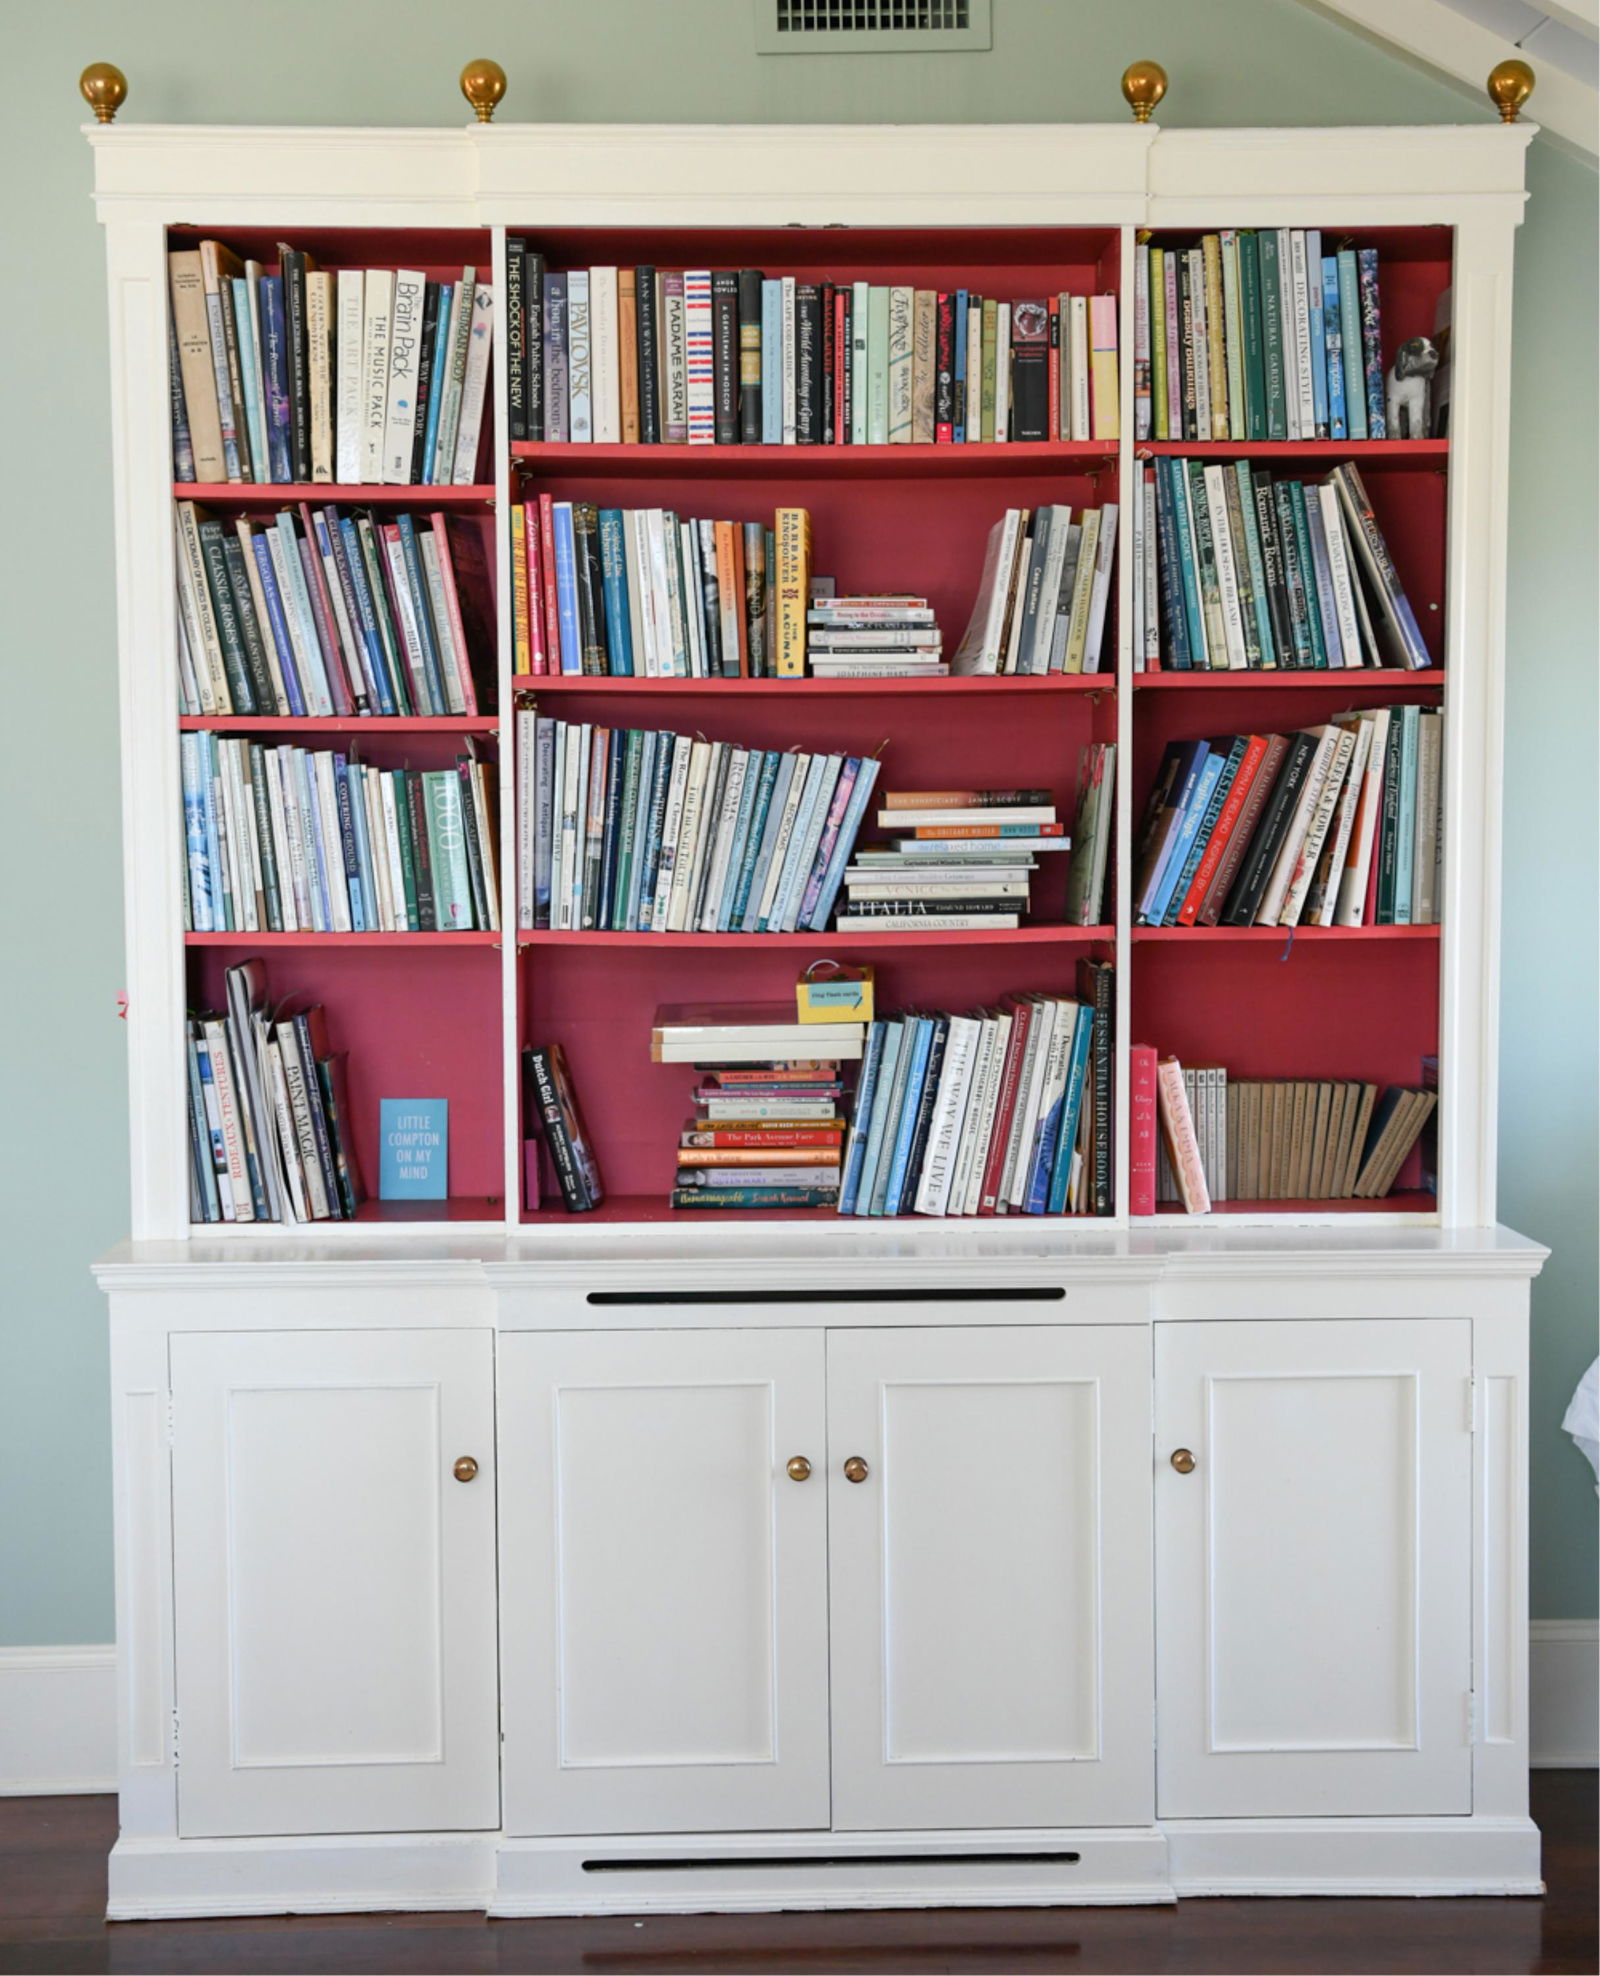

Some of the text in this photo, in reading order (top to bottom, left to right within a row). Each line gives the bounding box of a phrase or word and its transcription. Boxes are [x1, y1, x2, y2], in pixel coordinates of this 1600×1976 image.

[461, 281, 473, 305] THE
[784, 300, 792, 322] CAPE
[1152, 253, 1164, 353] THE ENGLISH ROOM
[293, 321, 301, 355] VICTORIAN
[391, 282, 419, 379] Brain Pack
[455, 307, 470, 349] HUMAN
[509, 256, 522, 408] THE SHOCK OF THE NEW
[670, 299, 682, 366] MADAME
[722, 314, 730, 361] GENTLEMAN
[785, 323, 793, 342] COD
[1266, 294, 1277, 348] NATURAL
[1295, 281, 1310, 364] DECORATING
[294, 356, 302, 377] HOUSE
[345, 295, 360, 417] THE ART PACK
[370, 316, 387, 429] THE MUSIC PACK
[419, 360, 430, 383] WAY
[452, 351, 464, 385] BODY
[530, 304, 541, 409] English Public Schools
[551, 287, 563, 426] a lion in the bedroom
[569, 302, 589, 400] PAVLOVSK
[723, 363, 730, 372] IN
[785, 343, 793, 379] GARDEN
[916, 311, 930, 386] The Collector
[1330, 334, 1341, 397] the hamptons
[295, 379, 303, 398] BOOK
[419, 384, 427, 401] WE
[672, 371, 683, 421] SARAH
[723, 375, 731, 412] MOSCOW
[1269, 353, 1280, 400] GARDEN
[1300, 367, 1312, 408] STYLE
[414, 403, 426, 437] WORK
[1174, 465, 1192, 561] LIVING WITH BOOKS
[1193, 476, 1212, 550] LANNING ROPER
[1259, 486, 1278, 588] Romantic Rooms
[1279, 495, 1292, 543] GARDEN
[256, 543, 275, 599] PERGOLAS
[327, 519, 357, 619] GLORIOUS GARDENS
[782, 513, 790, 583] KINGSOLVER
[791, 513, 799, 584] BARBARA
[1135, 531, 1143, 561] PARIS
[1166, 515, 1181, 596] inspirational interiors
[183, 510, 214, 642] THE DICTIONARY OF ROSES IN COLOUR
[208, 545, 238, 646] CLASSIC ROSES
[529, 568, 540, 633] Toni Morrison
[1029, 567, 1042, 615] Casa Italiana
[1329, 529, 1353, 640] PRIVATE LANDSCAPES
[783, 603, 791, 660] LACUNA
[540, 742, 551, 788] Decorating
[676, 746, 689, 786] The Rose
[1289, 744, 1309, 790] NEW YORK
[1371, 740, 1384, 773] inside
[606, 756, 621, 827] London Living
[721, 761, 746, 824] ROOMS
[735, 753, 759, 844] THE CURTAIN BOOK
[1306, 735, 1354, 860] COLEFAX & FOWLER
[338, 781, 357, 873] COVERING GROUND
[433, 783, 463, 851] 1000
[540, 801, 550, 839] Antiques
[668, 802, 681, 844] Clematis
[776, 802, 797, 852] BEDROOMS
[859, 901, 928, 916] ITALIA
[885, 885, 939, 895] VENICE
[885, 919, 969, 928] CALIFORNIA COUNTRY
[532, 1054, 555, 1105] Dutch Girl
[1054, 1034, 1071, 1081] Decorating
[286, 1065, 317, 1165] PAINT MAGIC
[1096, 1019, 1107, 1190] ESSENTIAL HOUSE BOOK
[1167, 1070, 1183, 1112] LAURA
[388, 1132, 440, 1146] COMPTON
[397, 1115, 432, 1130] LITTLE
[744, 1133, 763, 1141] Park
[928, 1040, 969, 1194] THE WAY WE LIVE
[396, 1149, 432, 1163] ON MY
[399, 1166, 428, 1180] MIND
[555, 1124, 572, 1172] AUDREY HEPBURN
